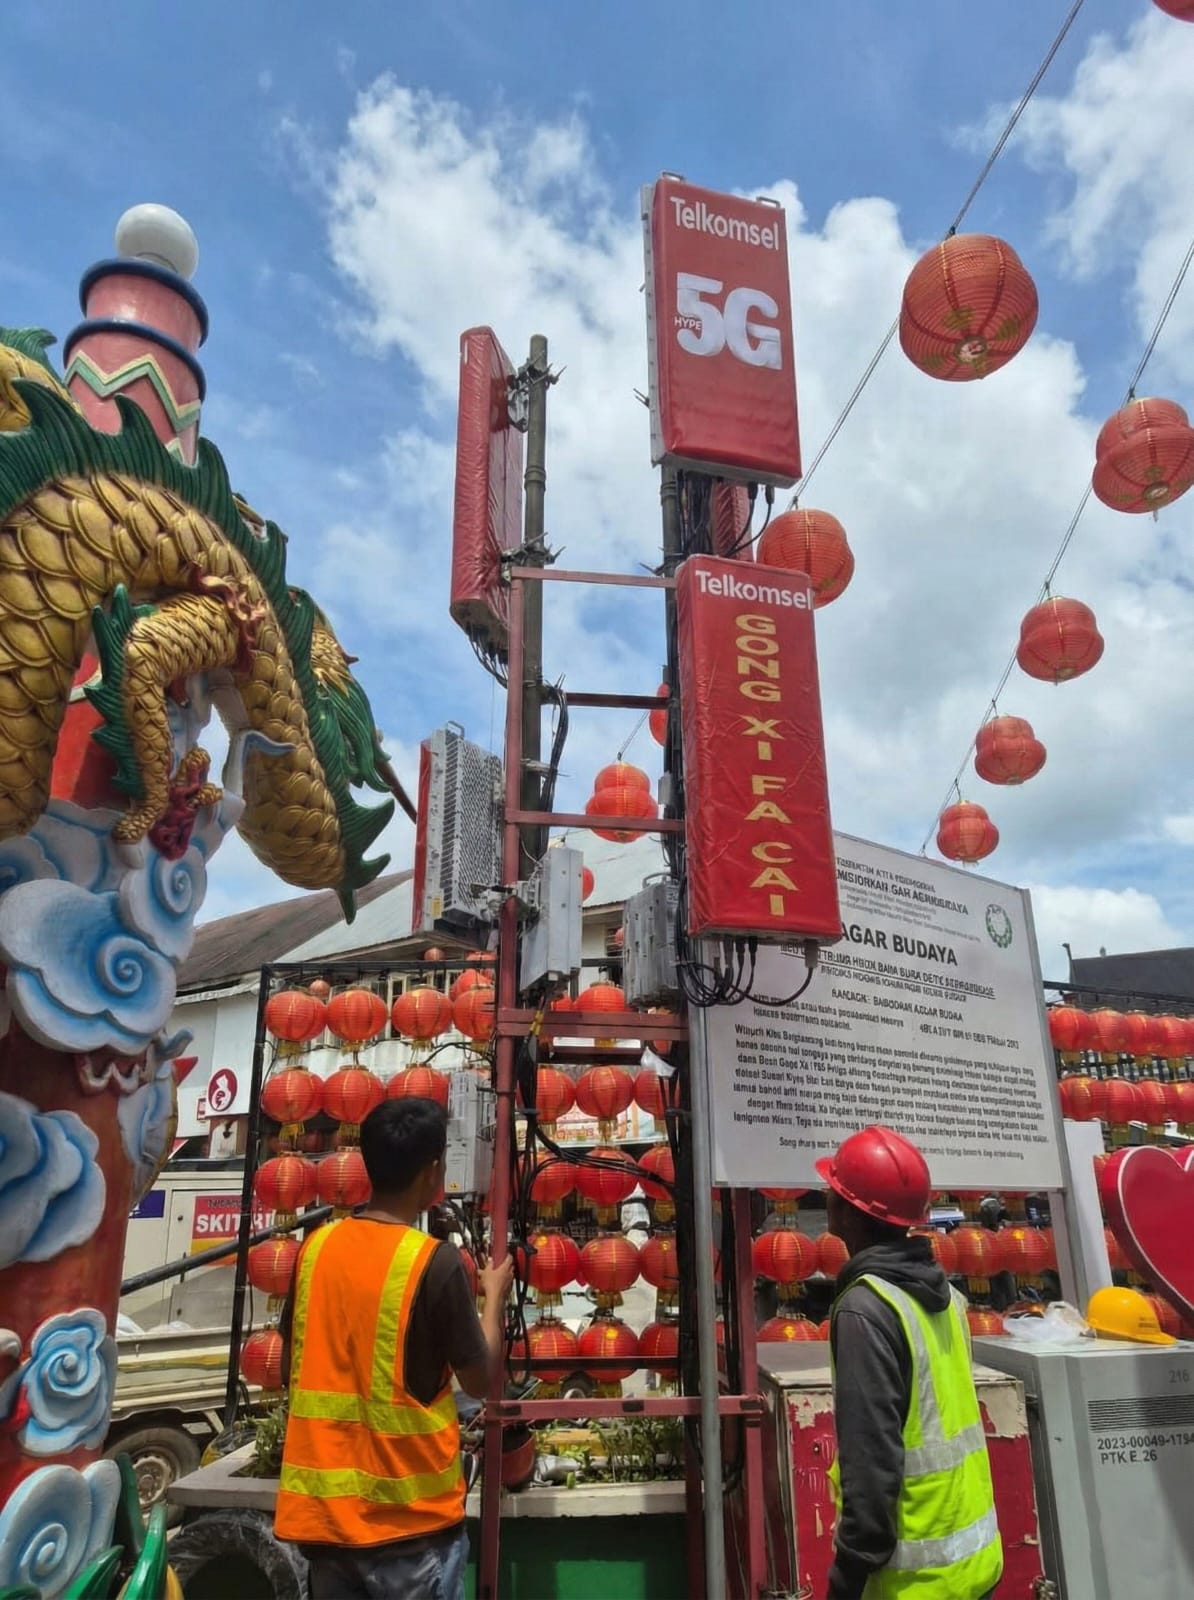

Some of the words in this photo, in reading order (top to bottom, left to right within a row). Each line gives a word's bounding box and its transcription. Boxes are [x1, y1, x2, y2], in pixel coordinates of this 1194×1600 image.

[670, 195, 779, 250] Telkomsel
[673, 315, 702, 330] HYPE
[676, 272, 783, 370] 5G
[695, 570, 813, 611] Telkomsel
[735, 613, 782, 702] GONG
[739, 714, 785, 762] XI
[893, 935, 958, 966] BUDAYA
[1100, 1450, 1127, 1464] PTK
